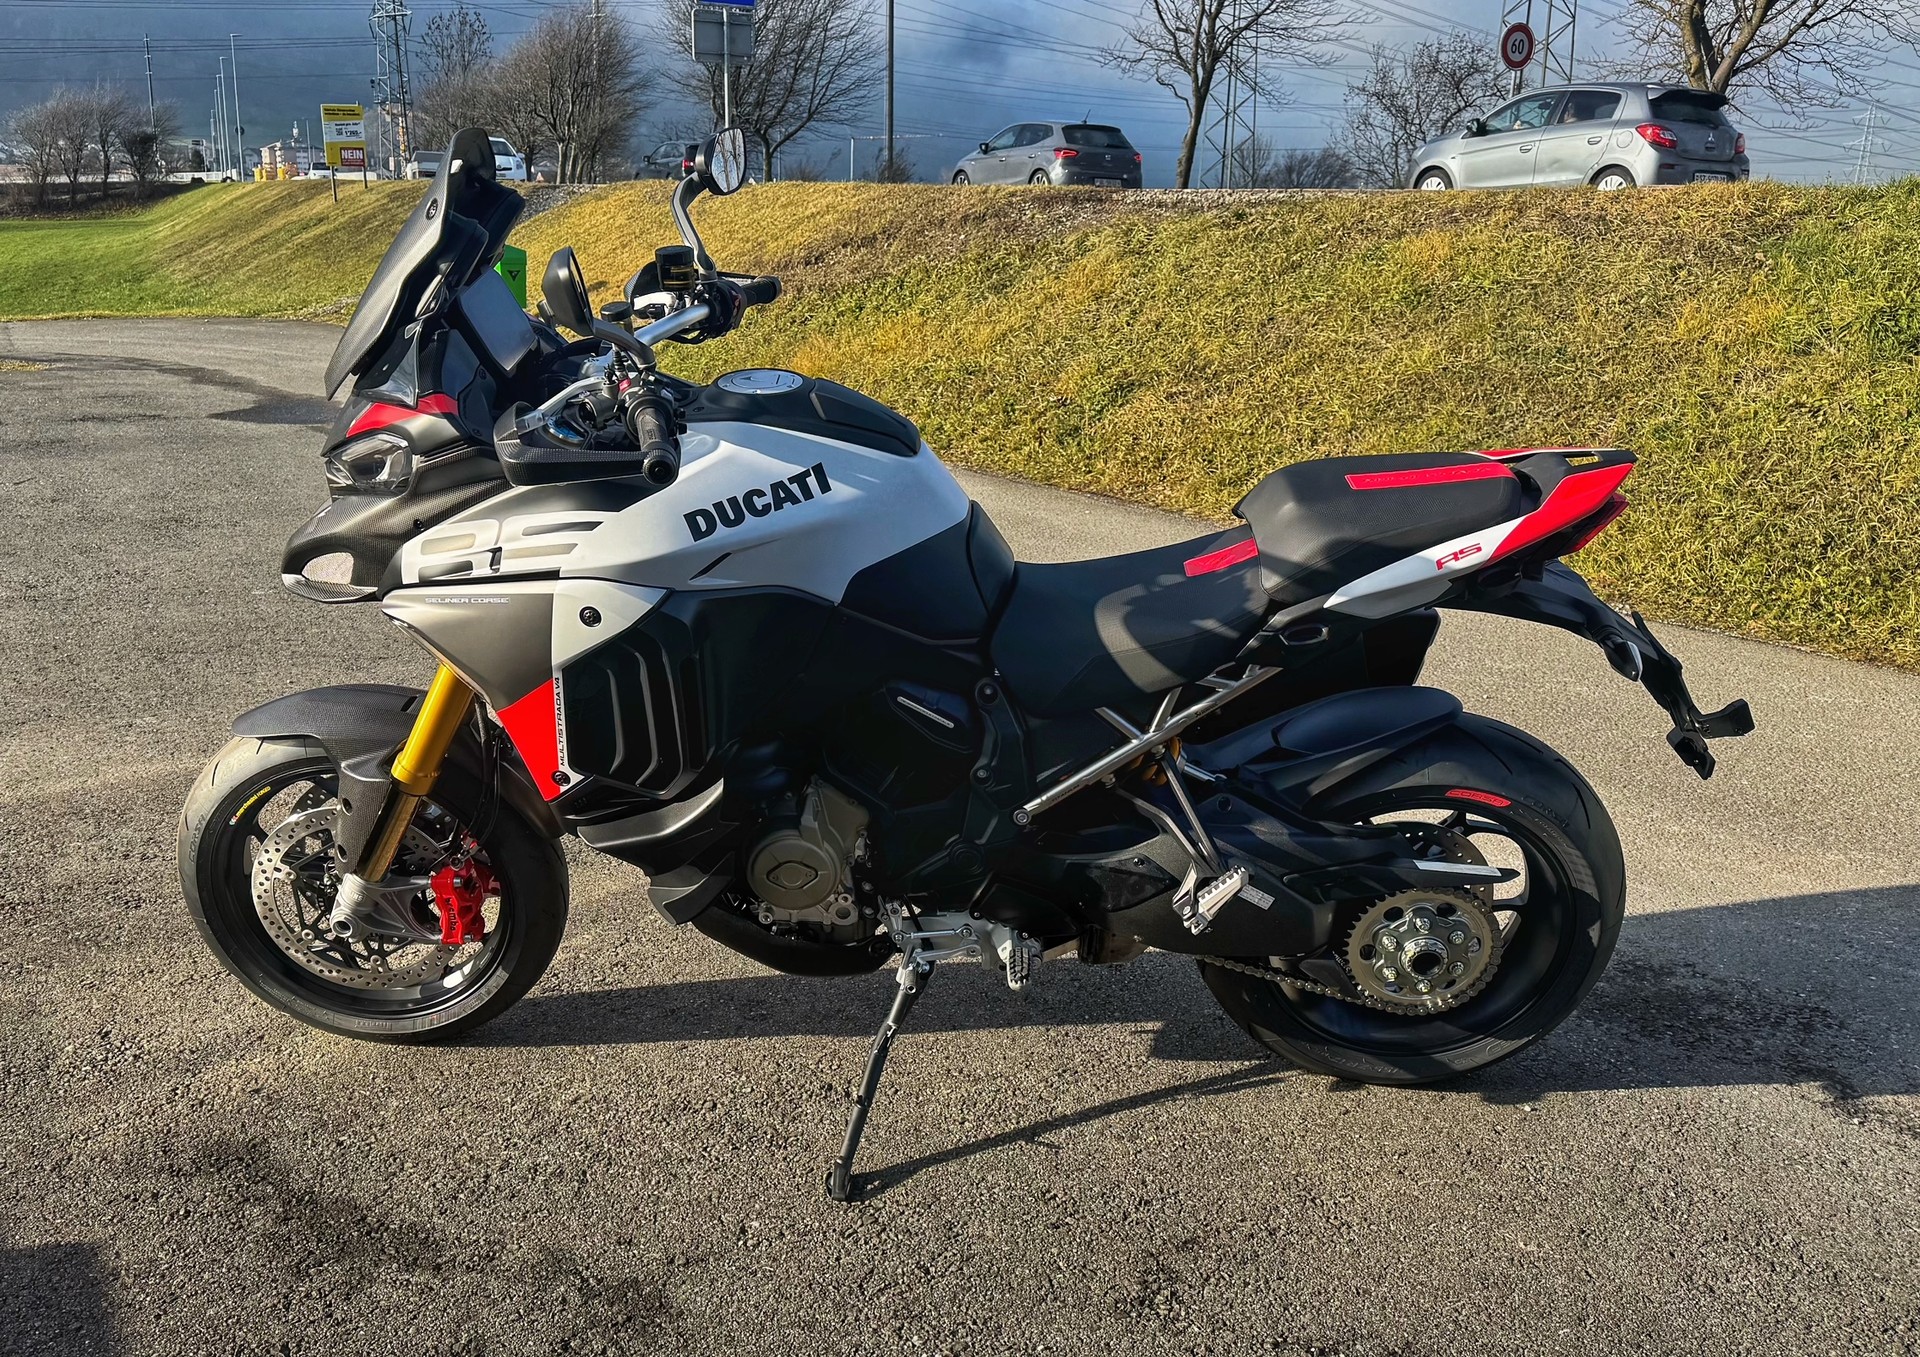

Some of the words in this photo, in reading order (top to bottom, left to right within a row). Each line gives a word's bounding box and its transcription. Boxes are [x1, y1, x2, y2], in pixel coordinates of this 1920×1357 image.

[1510, 38, 1525, 55] 60
[341, 149, 363, 159] NEIN
[683, 462, 832, 543] DUCATI
[1435, 542, 1482, 571] RS
[554, 677, 561, 690] V4
[555, 691, 566, 767] MULTISTRADA
[1448, 789, 1505, 806] CORSA
[188, 813, 206, 865] CORSA
[445, 897, 459, 932] brembo
